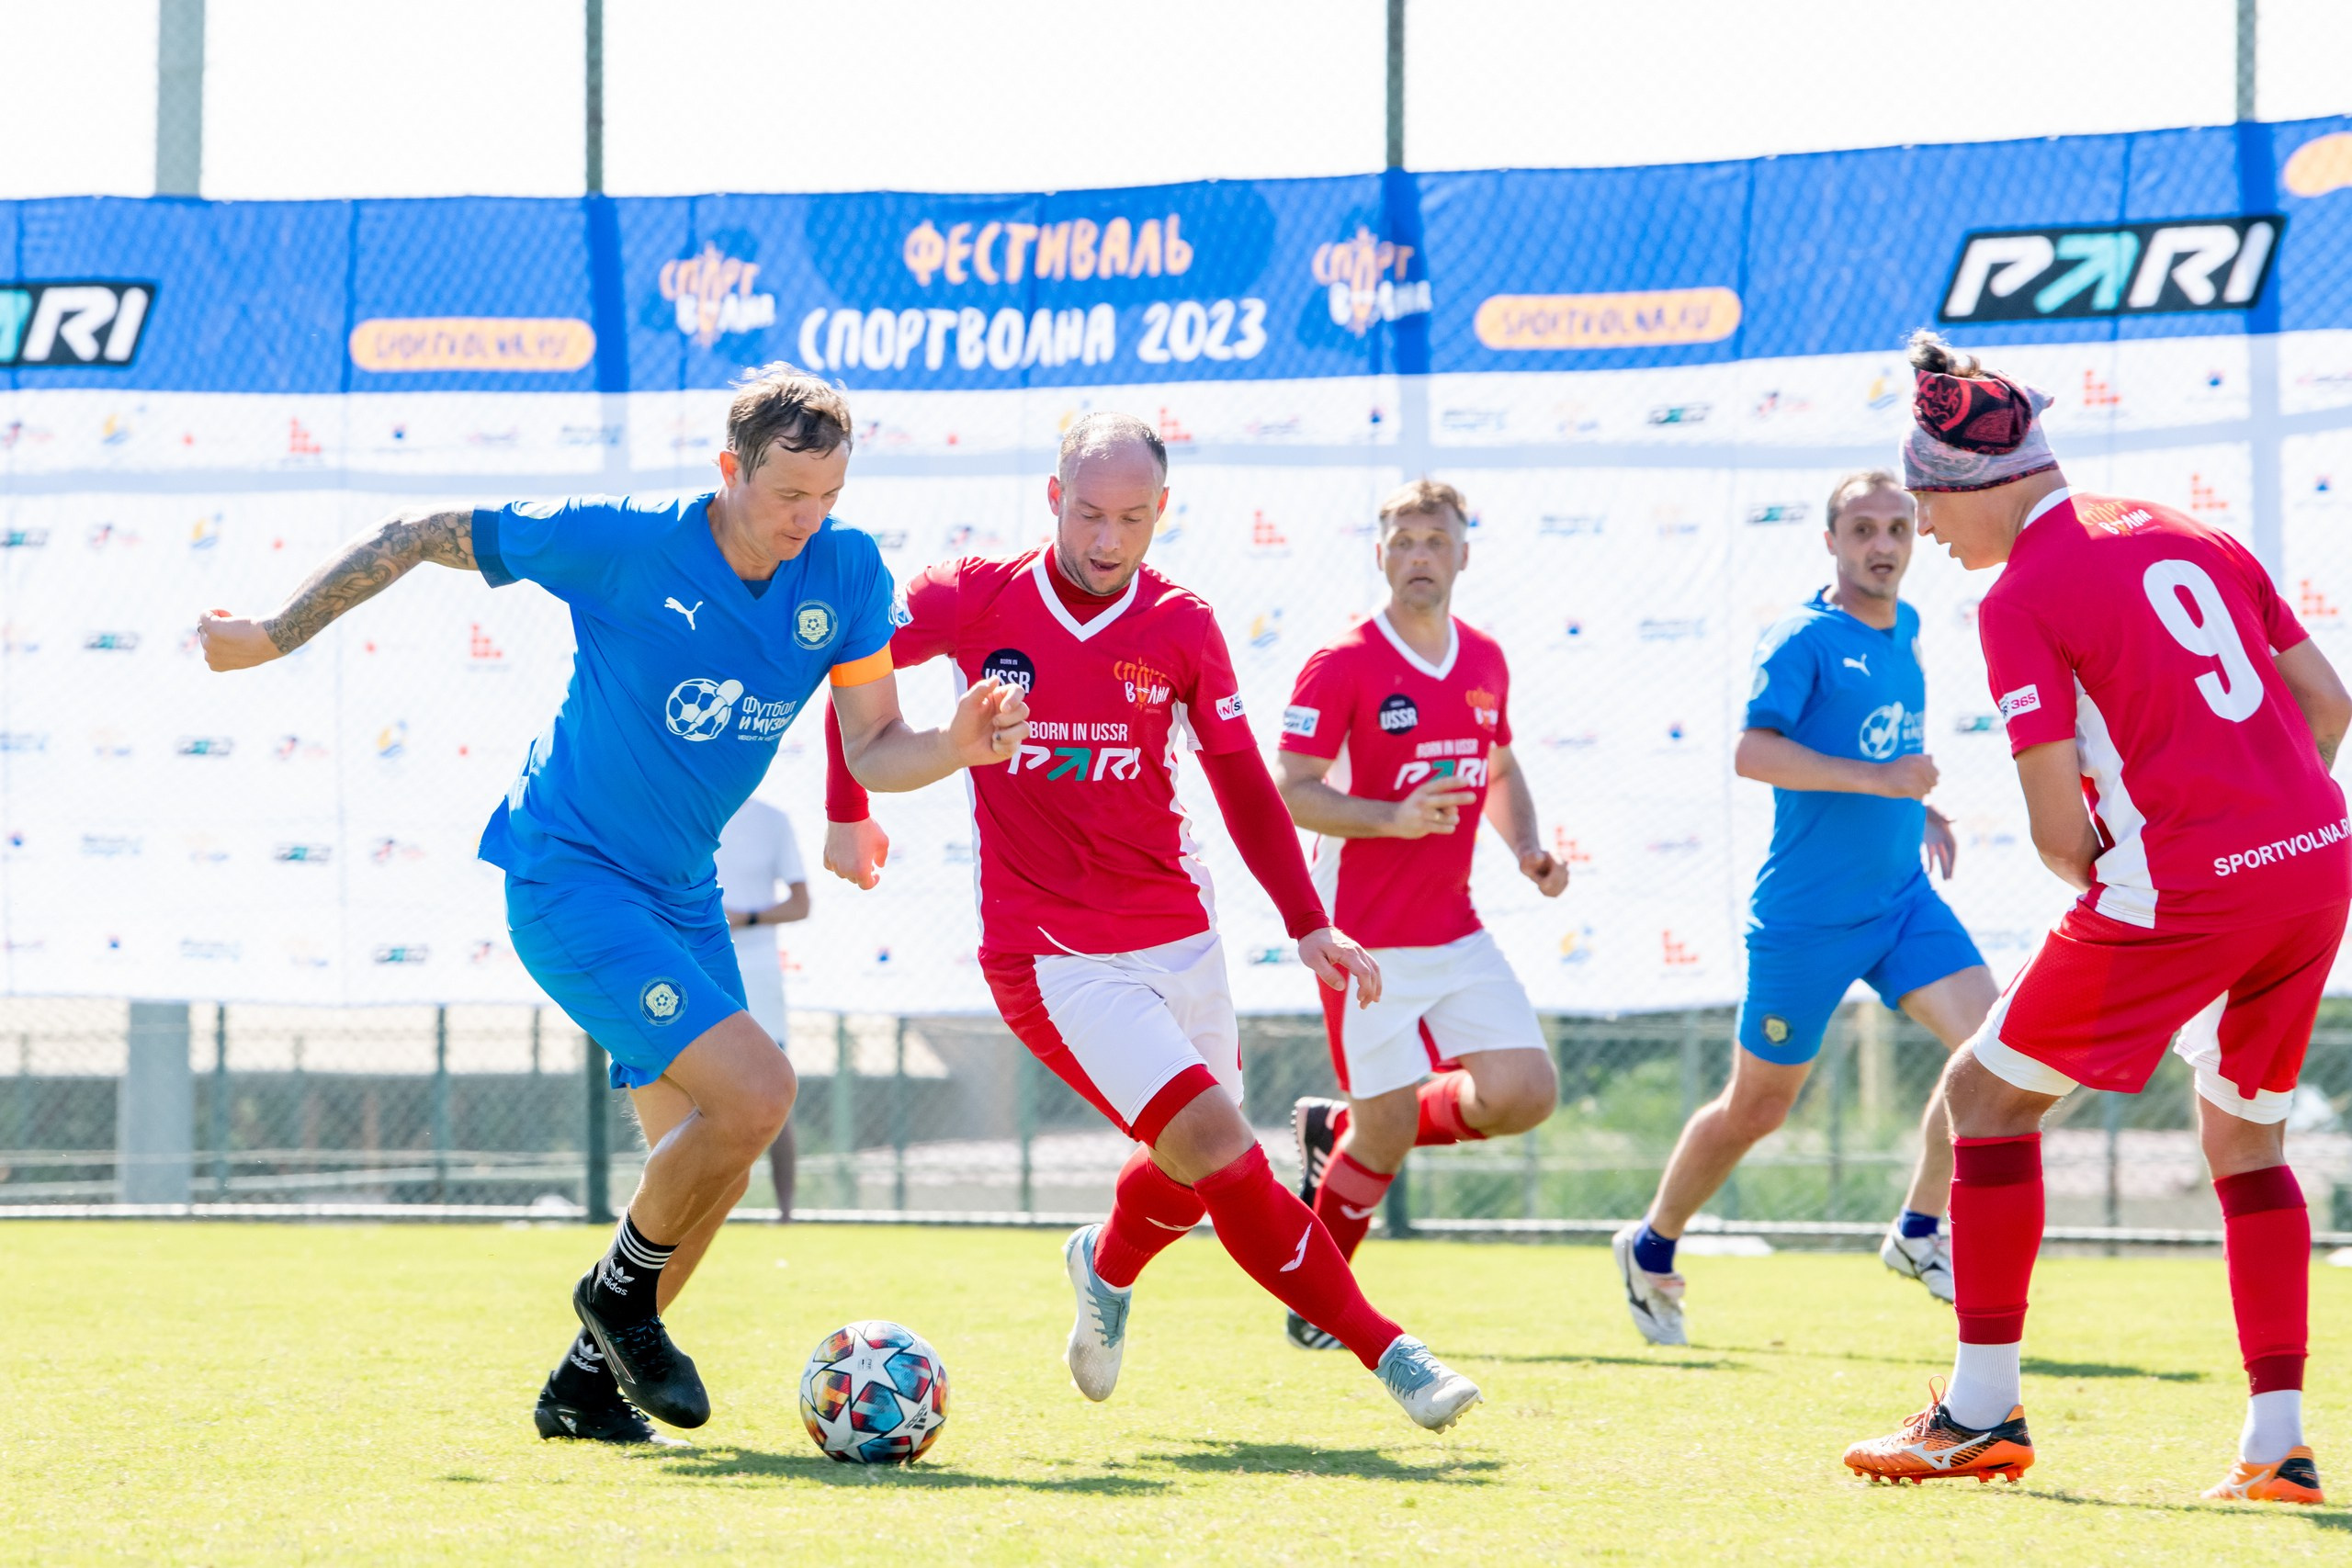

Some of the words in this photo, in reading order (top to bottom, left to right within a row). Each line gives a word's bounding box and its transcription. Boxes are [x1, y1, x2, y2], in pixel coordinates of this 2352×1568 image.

[904, 214, 1193, 286] ФЕСТИВАЛЬ
[1943, 220, 2276, 318] PARI
[797, 303, 1116, 371] СПОРТВОЛНА
[1136, 297, 1267, 365] 2023
[2143, 558, 2265, 723] 9
[1380, 706, 1419, 730] USSR
[2010, 693, 2037, 710] 365
[1029, 720, 1069, 740] BORN
[1072, 722, 1088, 741] IN
[1091, 723, 1129, 742] USSR
[1007, 743, 1142, 782] PARI
[602, 1271, 628, 1296] adidas
